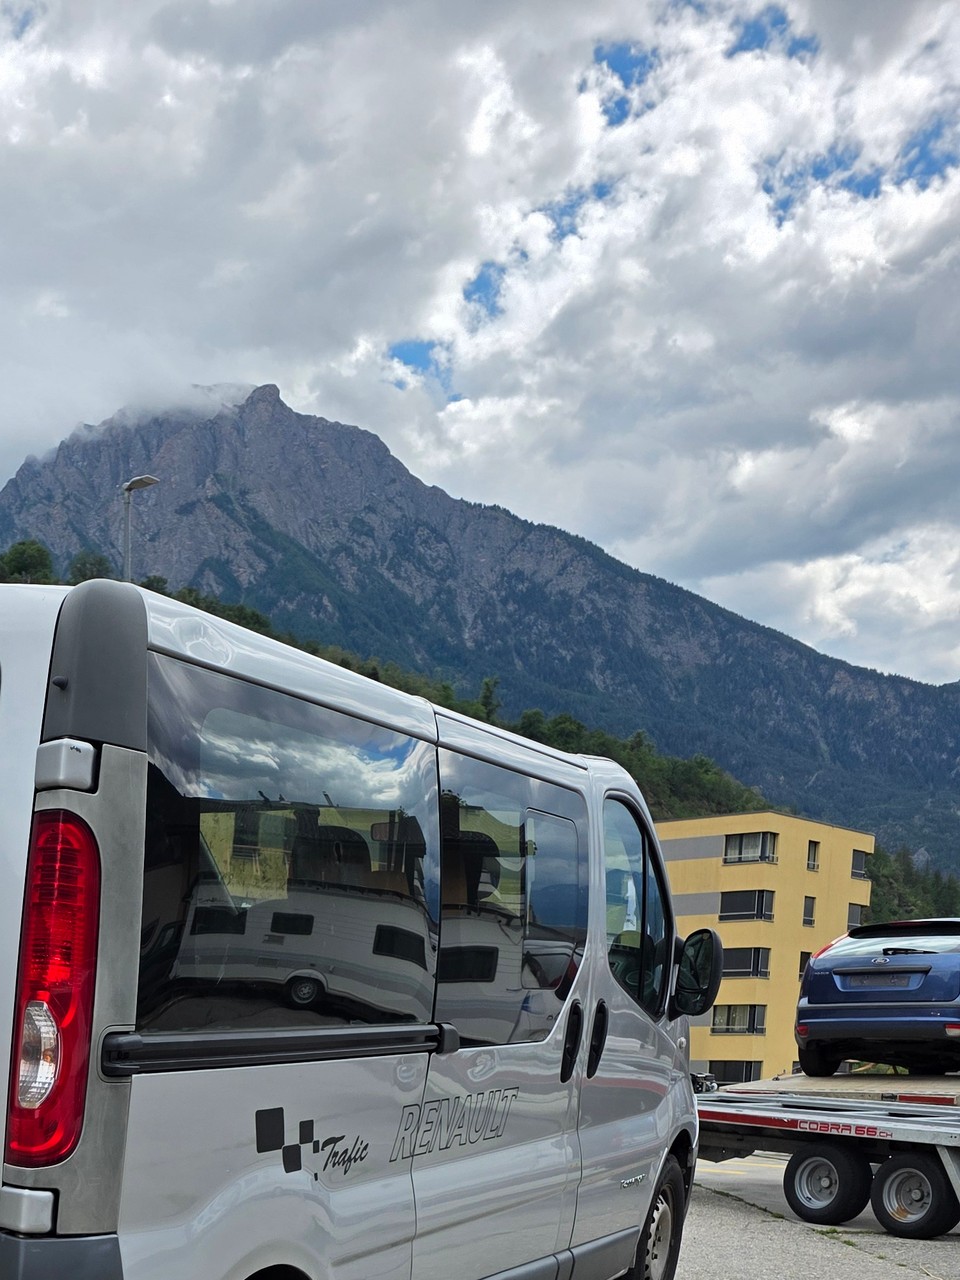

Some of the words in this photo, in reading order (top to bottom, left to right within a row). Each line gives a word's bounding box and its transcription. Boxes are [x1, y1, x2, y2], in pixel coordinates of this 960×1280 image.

[389, 1086, 520, 1163] RENAULT
[799, 1120, 852, 1135] COBRA
[321, 1135, 370, 1178] Trafic
